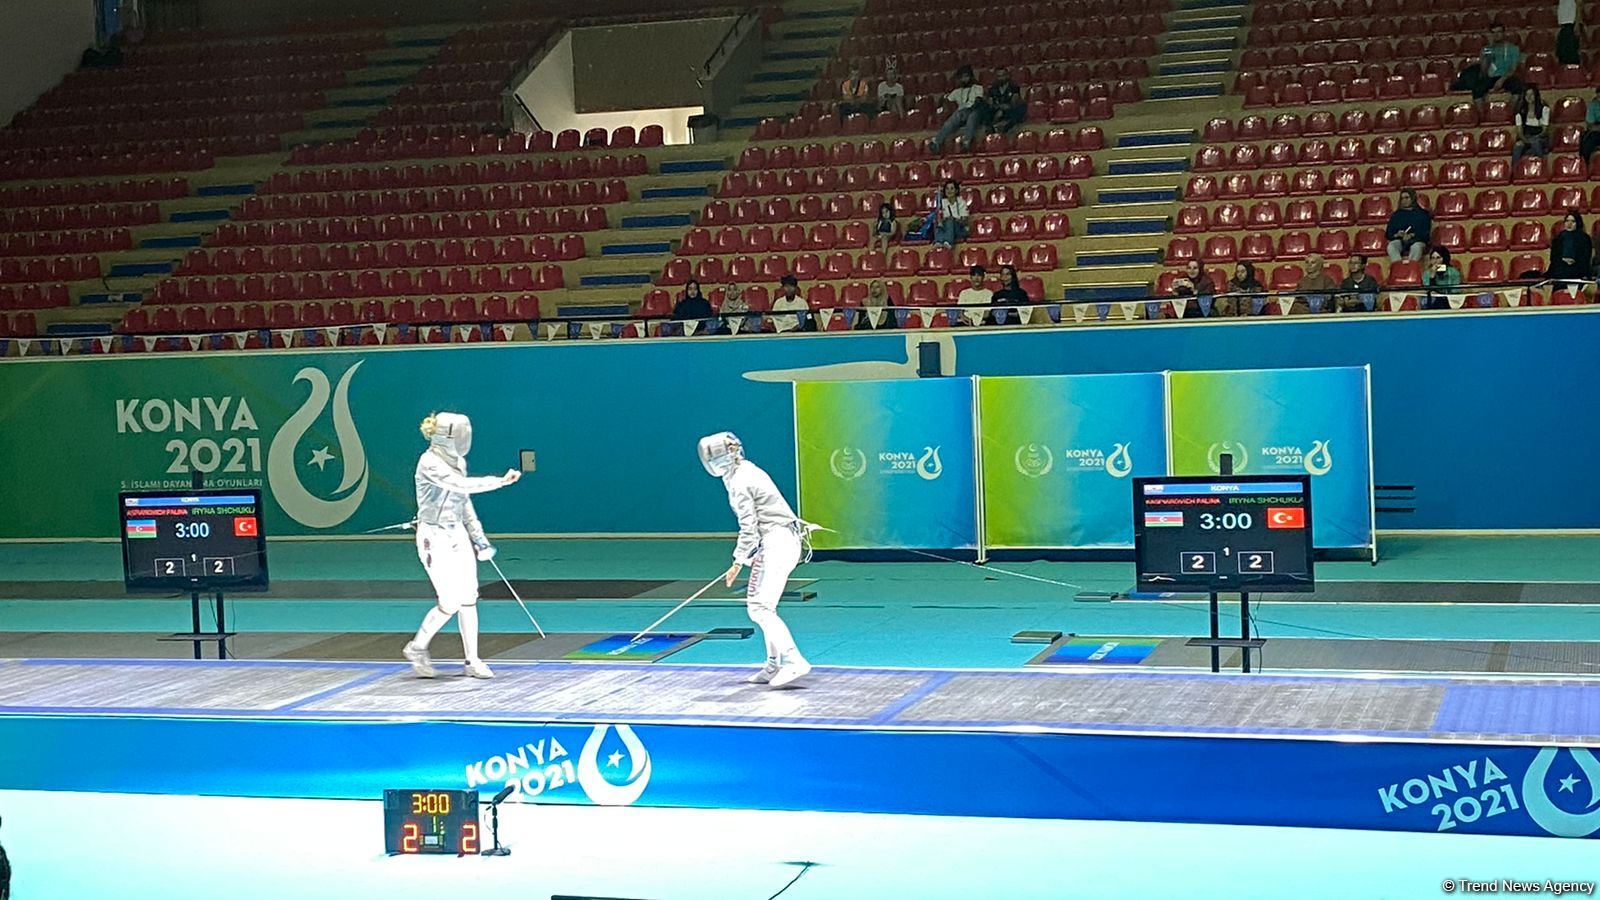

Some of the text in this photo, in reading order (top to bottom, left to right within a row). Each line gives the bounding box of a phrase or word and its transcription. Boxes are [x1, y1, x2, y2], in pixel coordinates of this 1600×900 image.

[115, 396, 259, 433] KONYA
[165, 437, 262, 473] 2021
[879, 452, 915, 461] KONYA
[1065, 449, 1104, 458] KONYA
[1262, 446, 1302, 455] KONYA
[891, 461, 916, 469] 2021
[1079, 458, 1105, 467] 2021
[1275, 455, 1303, 464] 2021
[217, 478, 263, 488] OYUNLARI
[1210, 484, 1240, 492] KONYA
[1200, 513, 1252, 530] 3:00
[175, 522, 210, 538] 3:00
[191, 554, 197, 562] 1
[1223, 547, 1230, 556] 1
[165, 562, 175, 574] 2
[214, 561, 224, 573] 2
[1191, 555, 1205, 569] 2
[1249, 555, 1263, 569] 2
[465, 736, 569, 788] KONYA
[505, 759, 577, 801] 2021
[1378, 757, 1508, 813] KONYA
[412, 794, 450, 813] 3:00
[1431, 784, 1519, 832] 2021
[403, 824, 418, 852] 2
[462, 824, 477, 852] 2
